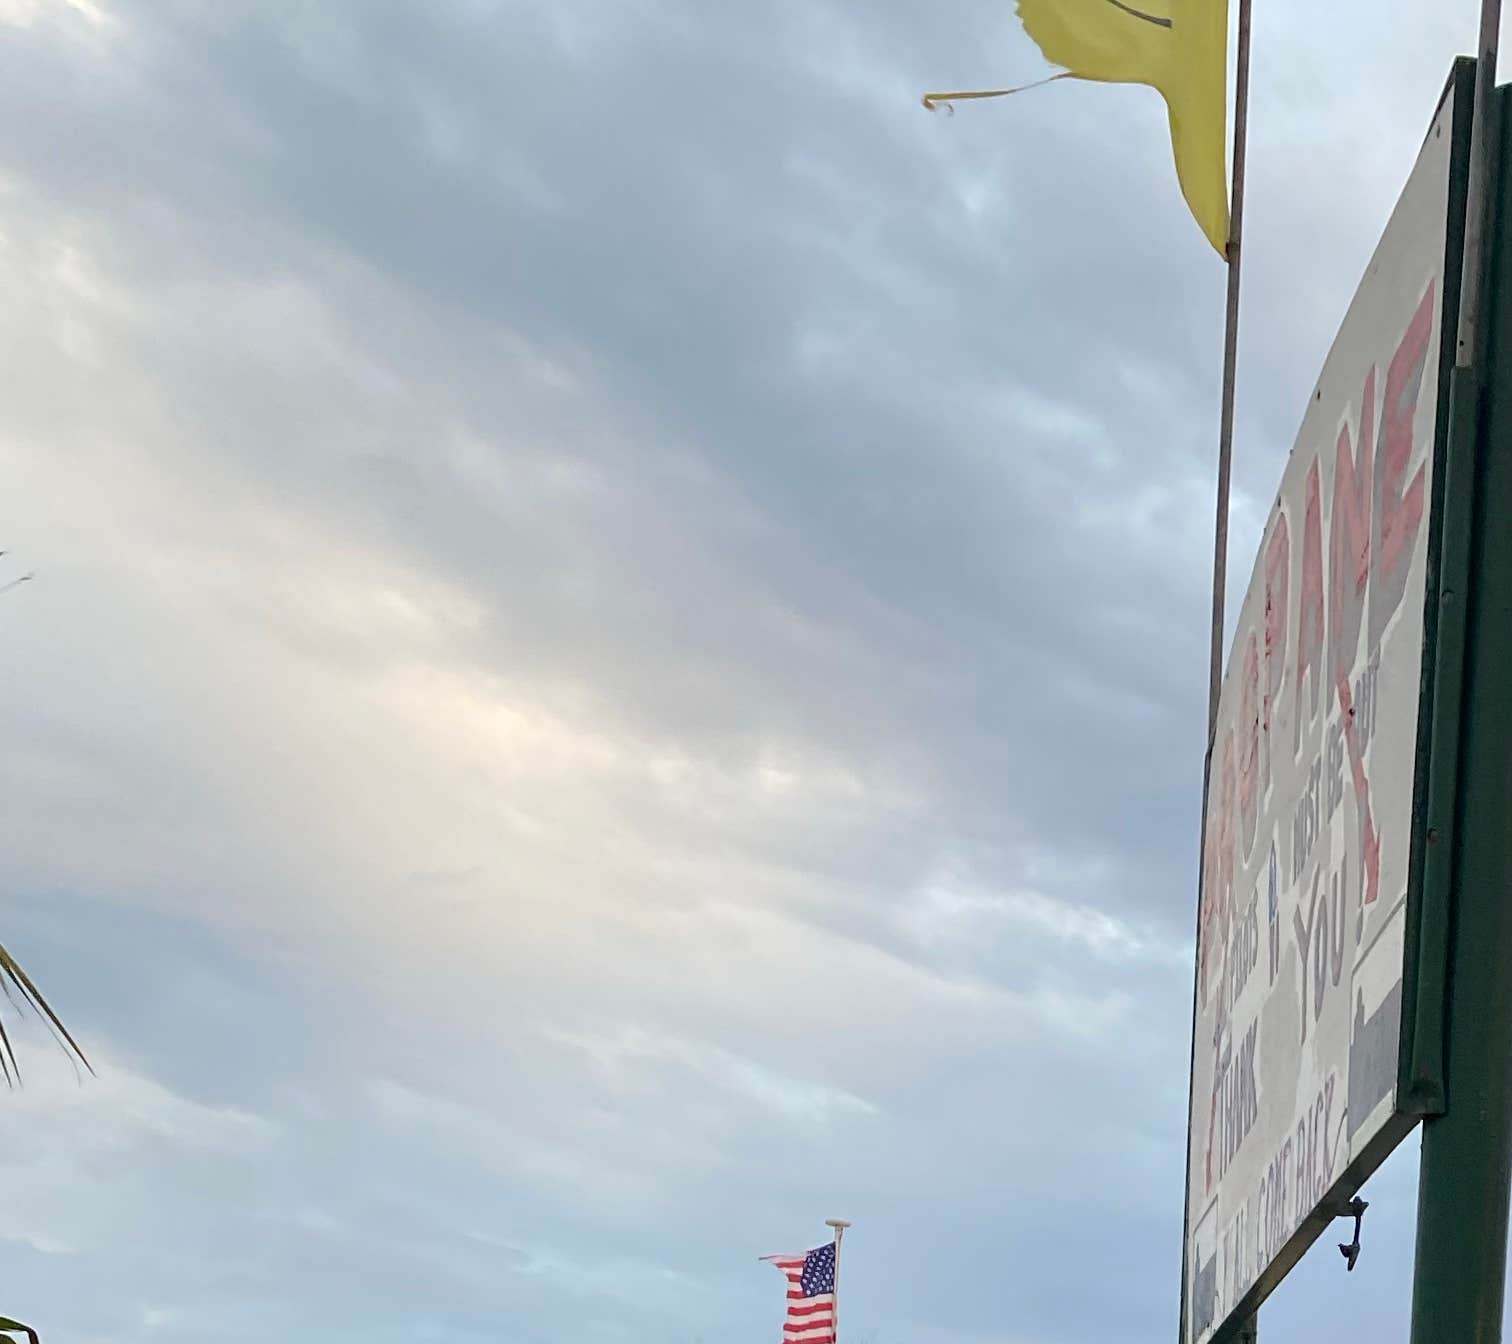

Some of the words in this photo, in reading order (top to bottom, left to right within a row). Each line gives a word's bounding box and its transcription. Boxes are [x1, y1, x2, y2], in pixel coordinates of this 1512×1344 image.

[1201, 277, 1436, 1010] PROPANE
[1217, 1015, 1258, 1182] THANK
[1293, 1071, 1336, 1231] BACK
